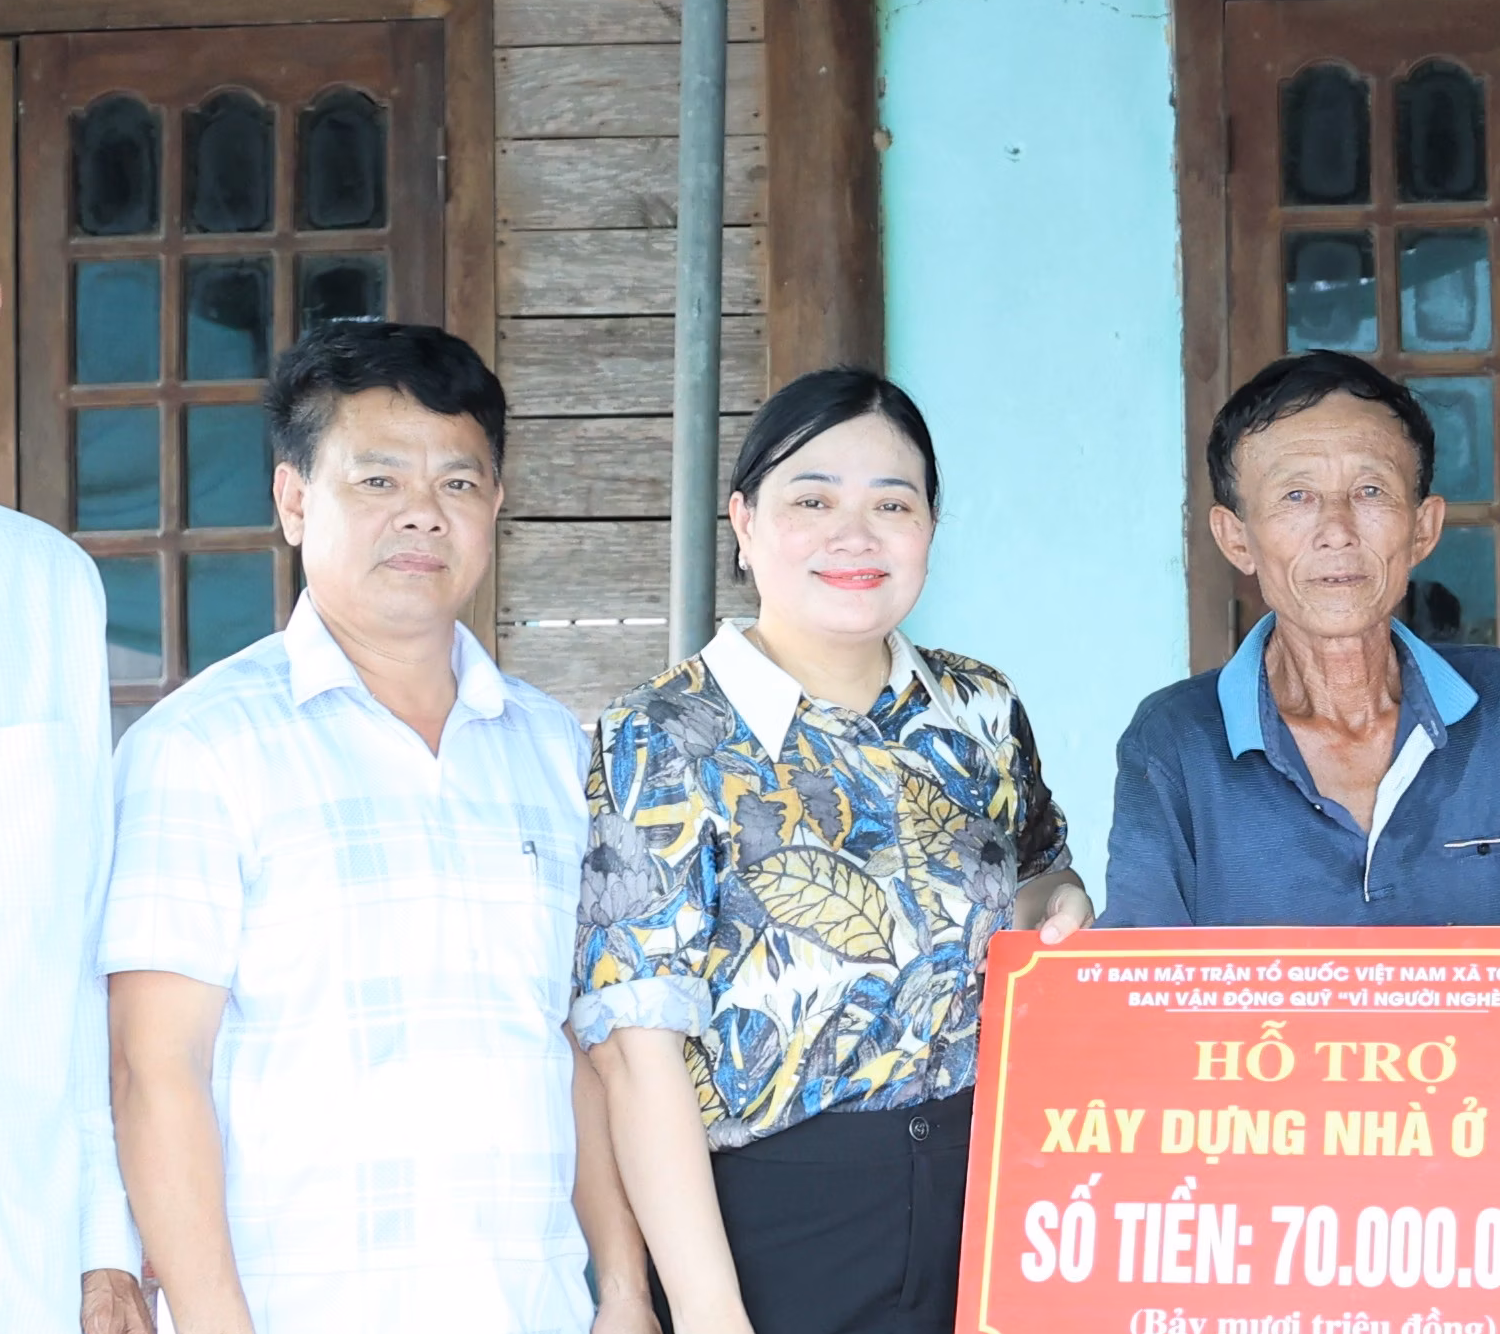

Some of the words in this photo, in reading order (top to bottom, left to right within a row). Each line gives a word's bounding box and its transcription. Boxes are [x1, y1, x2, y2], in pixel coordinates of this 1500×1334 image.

[1108, 968, 1148, 982] BAN
[1154, 964, 1195, 985] MẶT
[1200, 963, 1250, 985] TRẬN
[1256, 959, 1282, 981] TỔ
[1288, 960, 1349, 982] QUỐC
[1355, 963, 1395, 985] VIỆT
[1400, 967, 1446, 981] NAM
[1452, 964, 1481, 981] XÃ
[1128, 991, 1169, 1006] BAN
[1175, 988, 1217, 1009] VẬN
[1223, 988, 1284, 1009] ĐỘNG
[1289, 988, 1332, 1007] QUỸ
[1338, 989, 1368, 1006] “VÌ
[1374, 989, 1440, 1007] NGƯỜI
[1192, 1020, 1295, 1082] HỖ
[1315, 1035, 1458, 1094] TRỢ
[1040, 1098, 1147, 1153] XÂY
[1160, 1104, 1306, 1164] DỰNG
[1323, 1102, 1434, 1157] NHÀ
[1451, 1096, 1488, 1158] Ở
[1020, 1173, 1103, 1283] SỐ
[1113, 1176, 1254, 1285] TIỀN:
